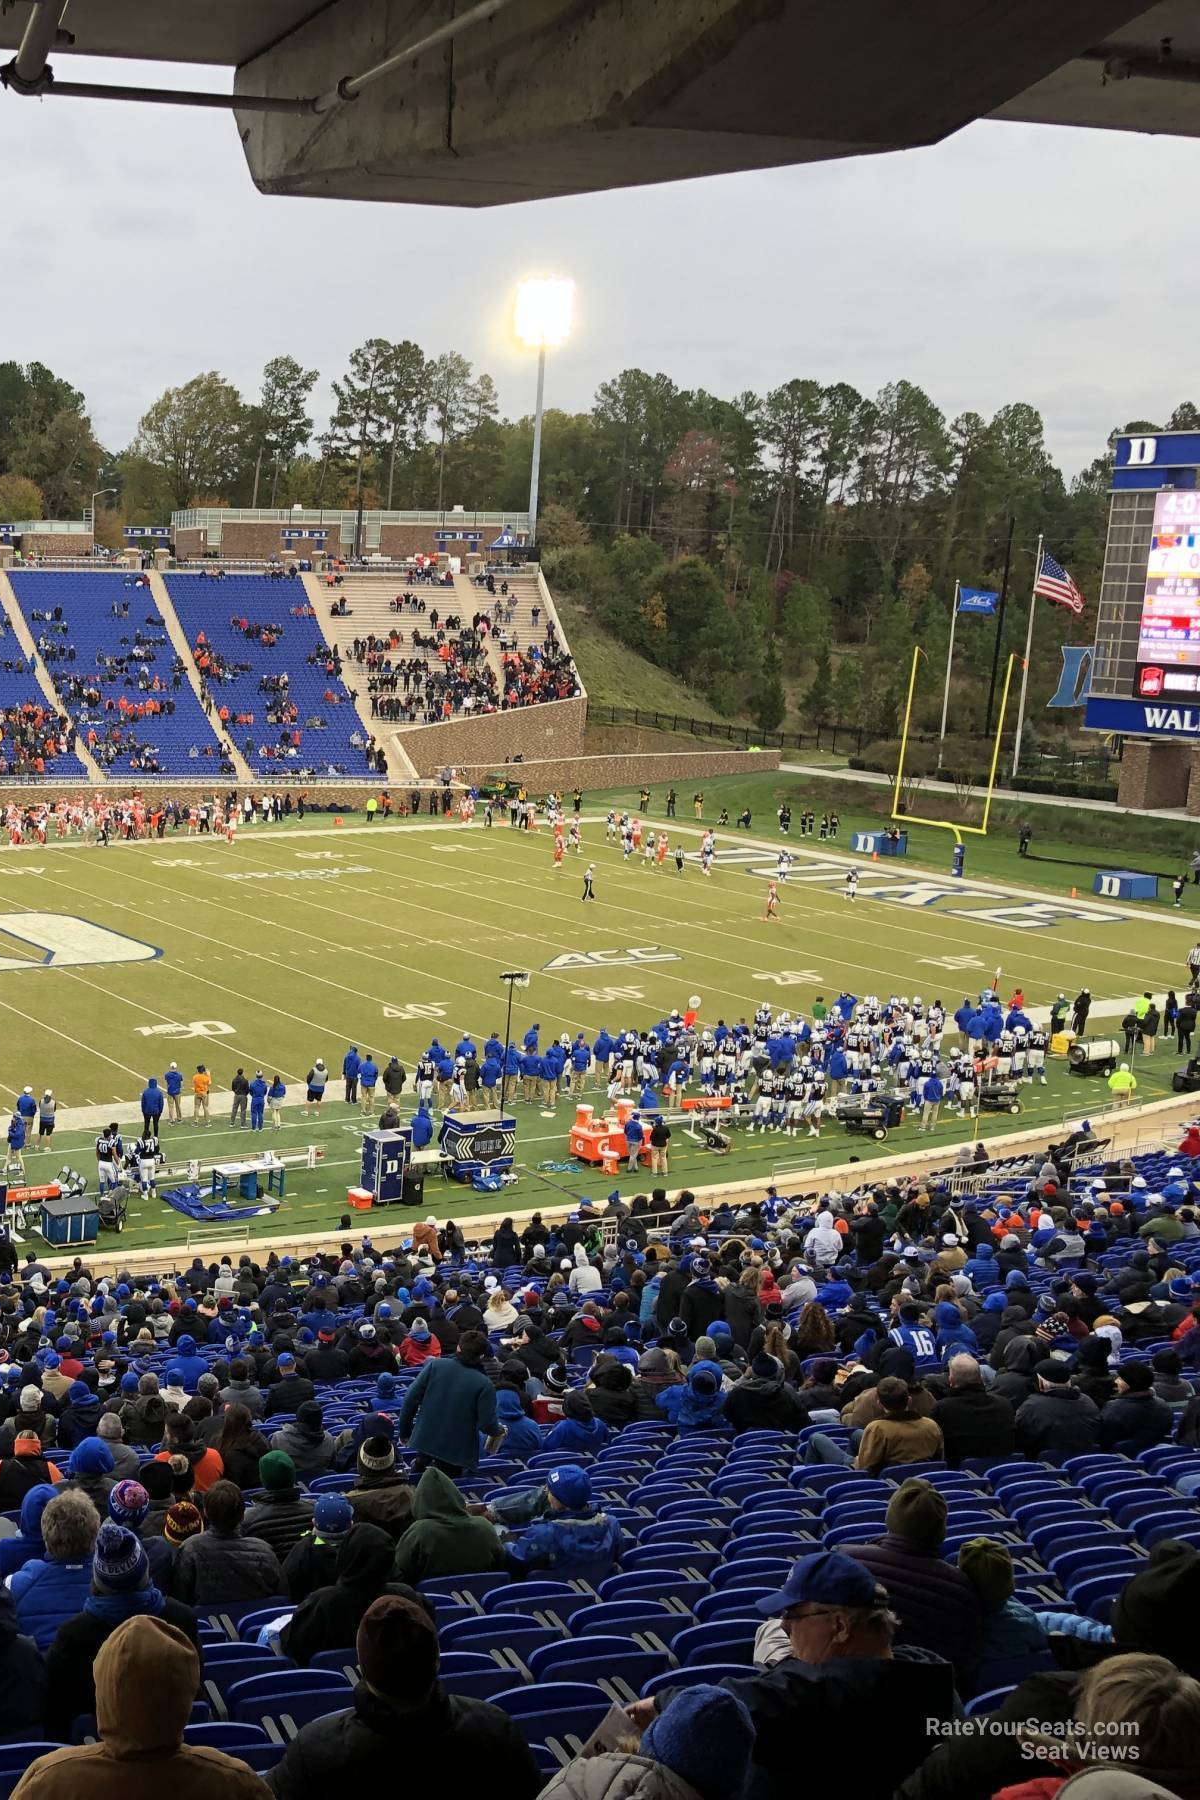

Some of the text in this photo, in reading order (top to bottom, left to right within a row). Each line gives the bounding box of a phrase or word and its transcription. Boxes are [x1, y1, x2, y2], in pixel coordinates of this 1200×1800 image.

[1127, 438, 1157, 465] D
[1144, 707, 1200, 732] WAL
[856, 834, 875, 853] D
[1098, 876, 1121, 897] D
[540, 945, 683, 971] ACC
[382, 1003, 448, 1020] 40
[576, 1139, 584, 1151] G
[386, 1160, 398, 1174] D
[15, 1189, 48, 1198] GATRADE
[910, 1331, 934, 1356] 16
